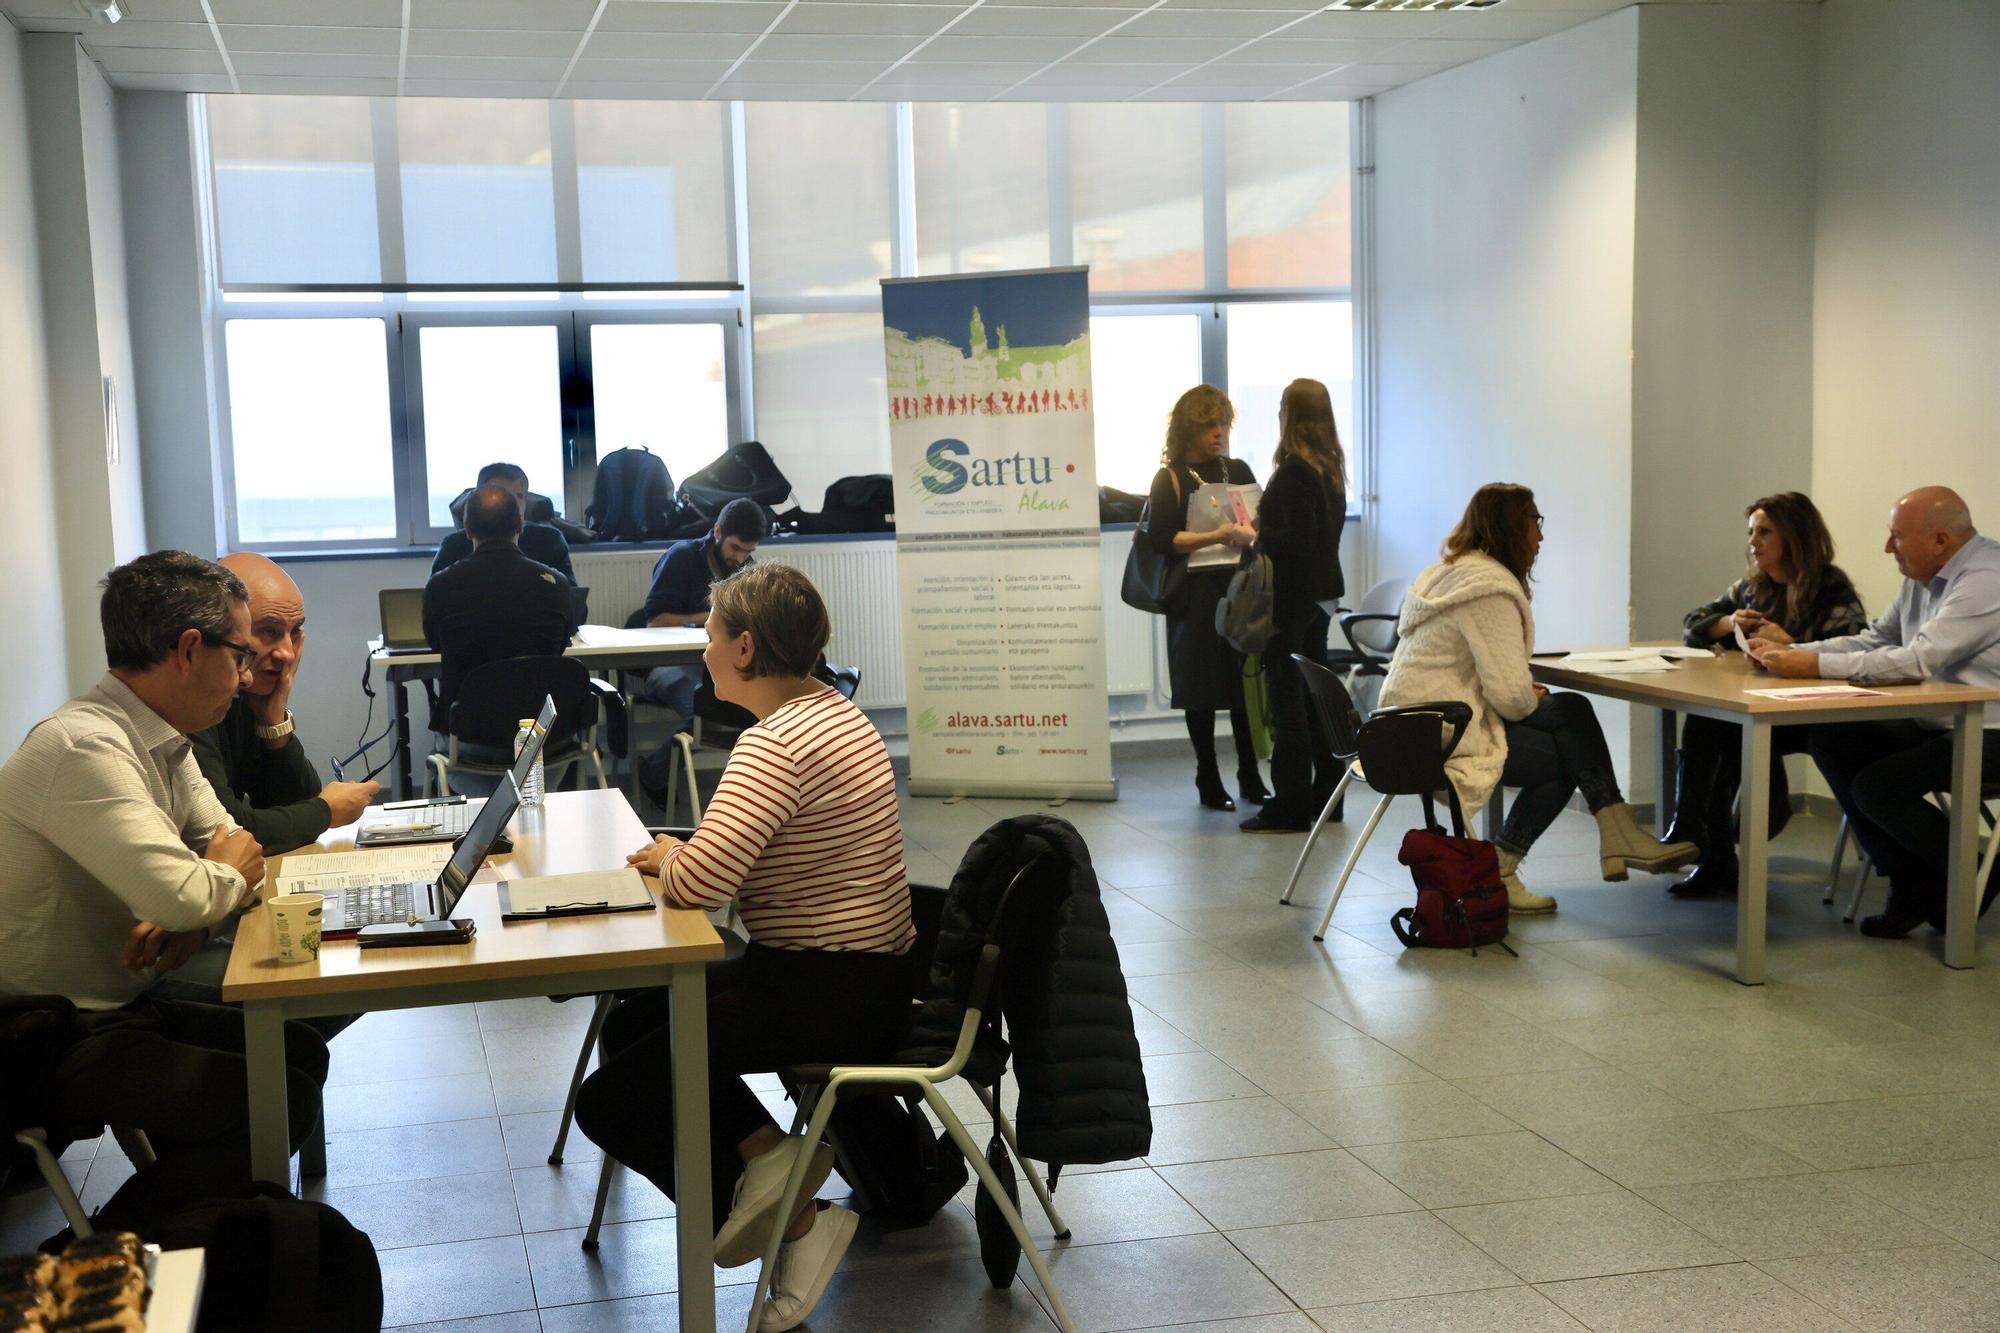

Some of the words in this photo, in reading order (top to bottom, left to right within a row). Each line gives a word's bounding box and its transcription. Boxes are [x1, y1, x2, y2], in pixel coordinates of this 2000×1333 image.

[921, 438, 1053, 495] Sartu
[1018, 488, 1070, 513] Alava
[947, 711, 1068, 728] alava.sartu.net
